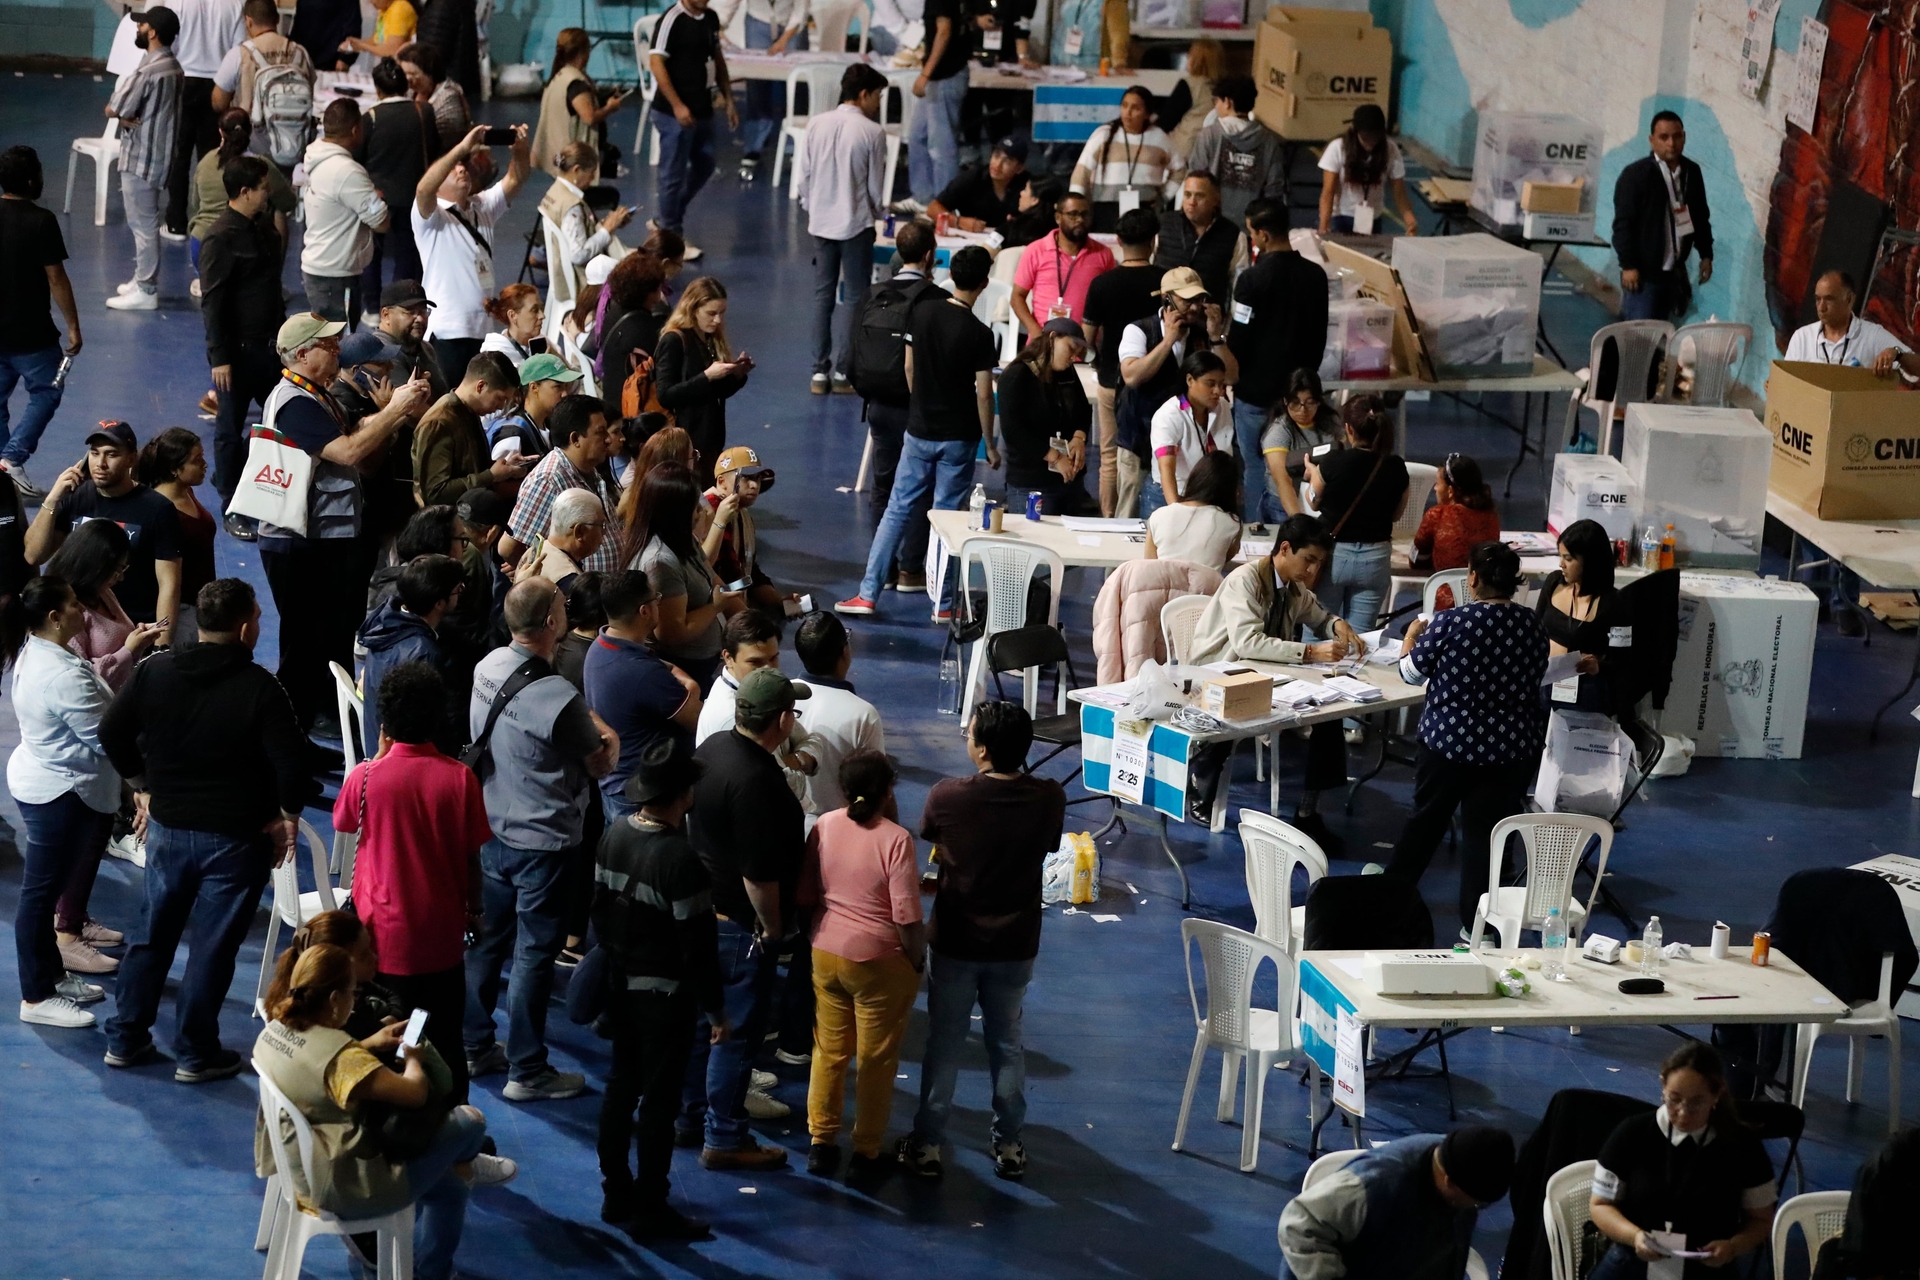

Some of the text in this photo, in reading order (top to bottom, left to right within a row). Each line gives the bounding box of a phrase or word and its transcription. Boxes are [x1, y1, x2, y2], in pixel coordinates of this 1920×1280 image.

[1330, 75, 1378, 94] CNE
[1545, 143, 1588, 160] CNE
[1366, 316, 1389, 327] CNE
[1781, 422, 1813, 456] CNE
[1874, 438, 1920, 461] CN
[746, 449, 758, 463] B
[254, 464, 293, 489] ASJ
[1601, 493, 1627, 504] CNE
[1768, 663, 1778, 704] NACIONAL
[1774, 615, 1783, 661] ELECTORAL
[1697, 622, 1716, 731] REPÚBLICA DE HONDURAS
[1117, 769, 1139, 786] 2025
[262, 1031, 294, 1058] ELECTORAL
